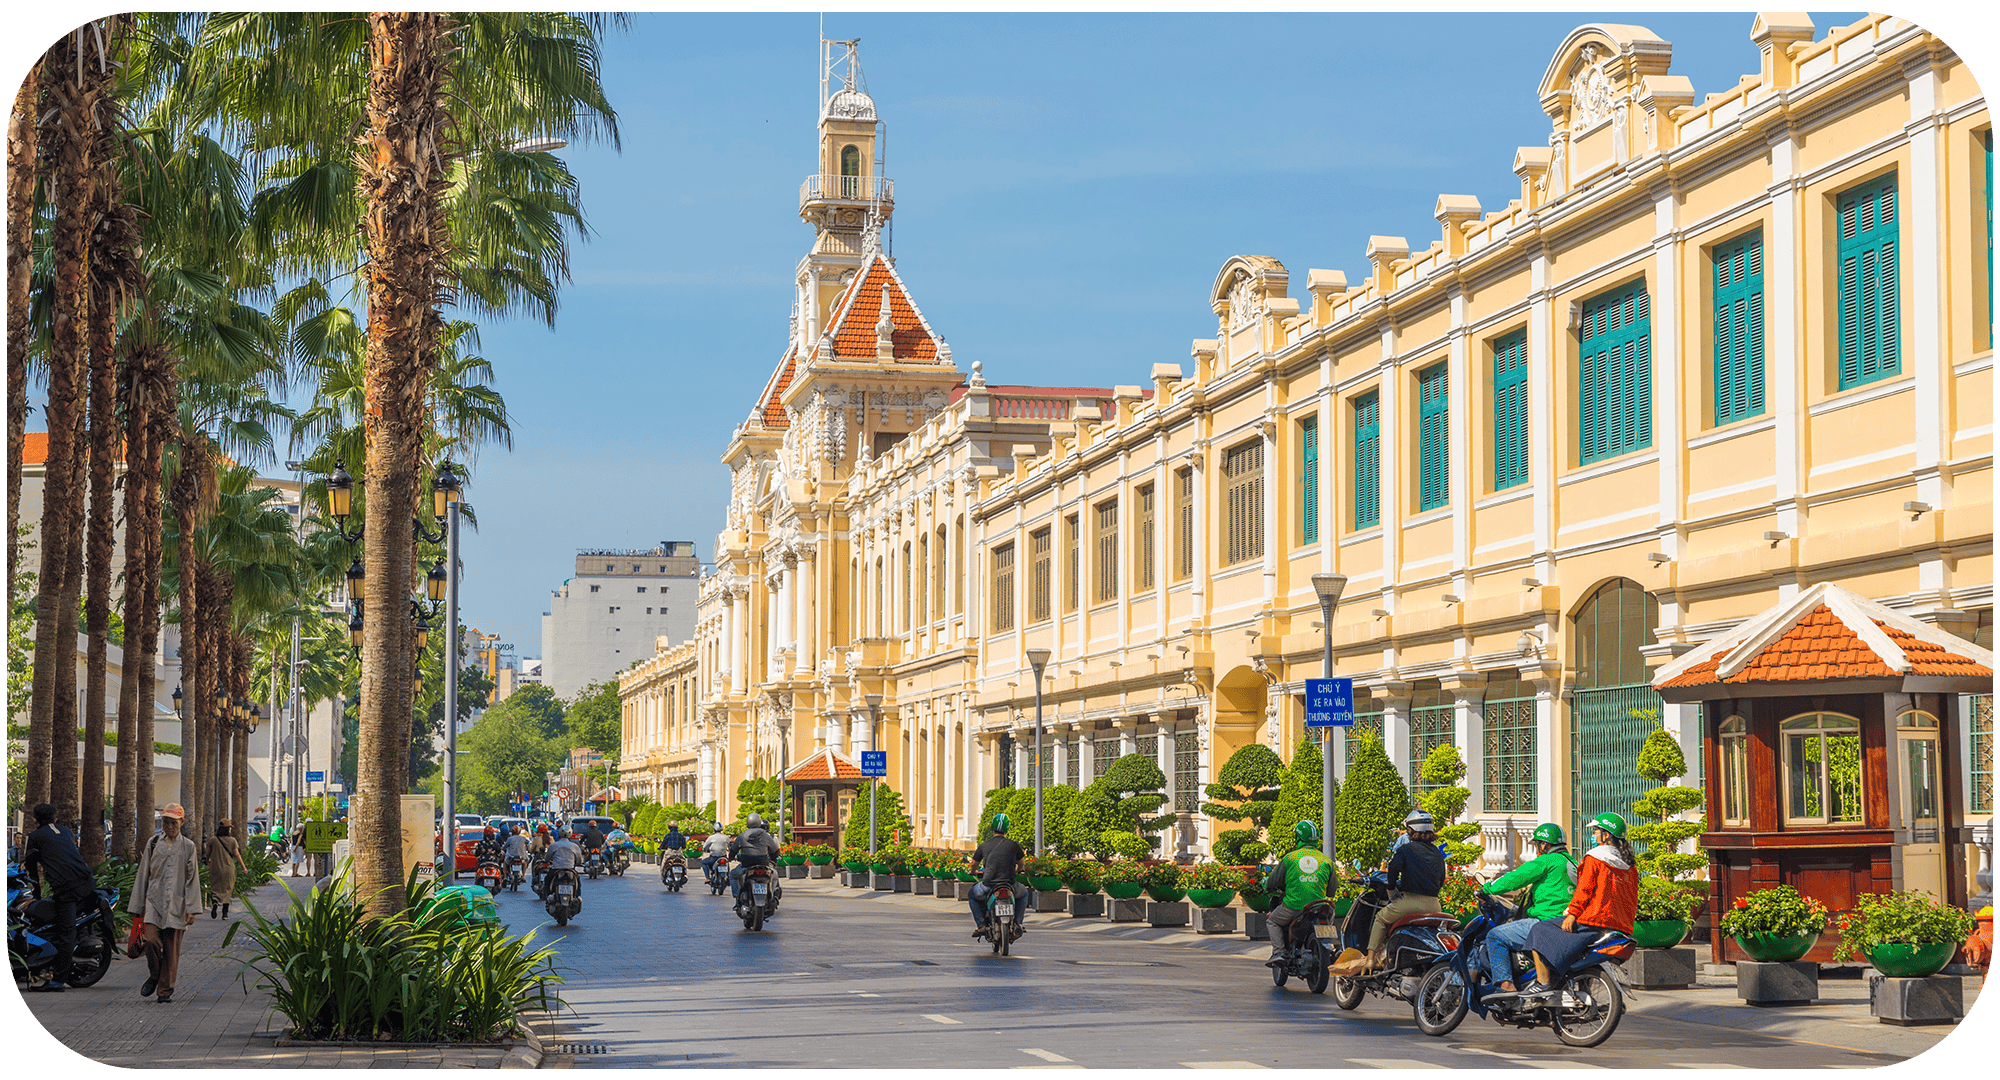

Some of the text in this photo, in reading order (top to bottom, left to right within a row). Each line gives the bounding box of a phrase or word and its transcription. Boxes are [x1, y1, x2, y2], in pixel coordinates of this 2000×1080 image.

[1317, 681, 1341, 693] CHÚ Ý
[1313, 695, 1346, 707] XE RA VÀO
[1602, 818, 1617, 829] Grab
[1299, 874, 1319, 882] Grab
